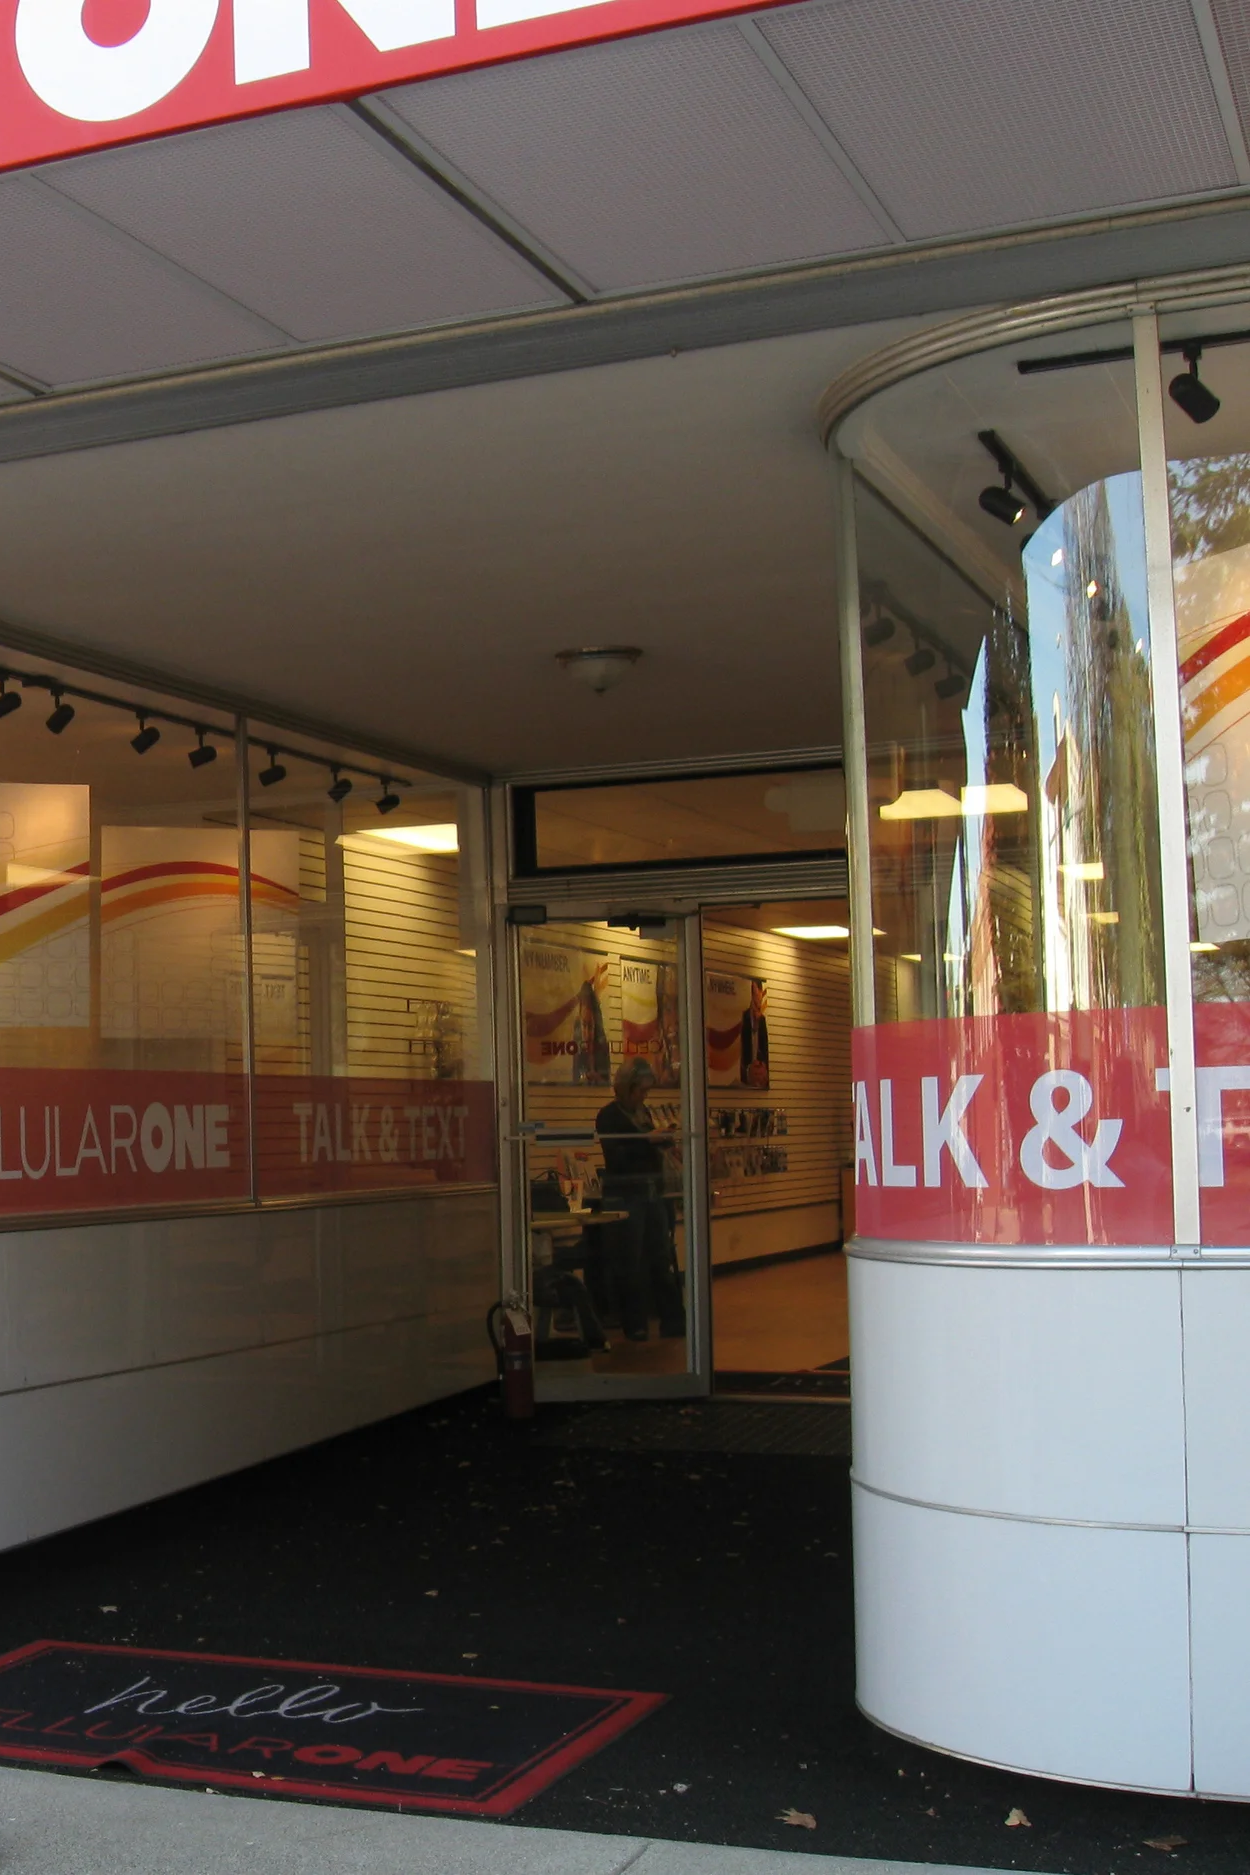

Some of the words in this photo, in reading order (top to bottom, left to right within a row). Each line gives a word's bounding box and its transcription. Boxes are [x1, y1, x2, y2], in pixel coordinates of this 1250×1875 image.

[294, 1102, 373, 1163] TALK
[379, 1104, 400, 1163] &
[404, 1104, 470, 1162] TEXT
[852, 1074, 989, 1189] ALK
[1020, 1069, 1127, 1191] &
[84, 1676, 425, 1724] hello
